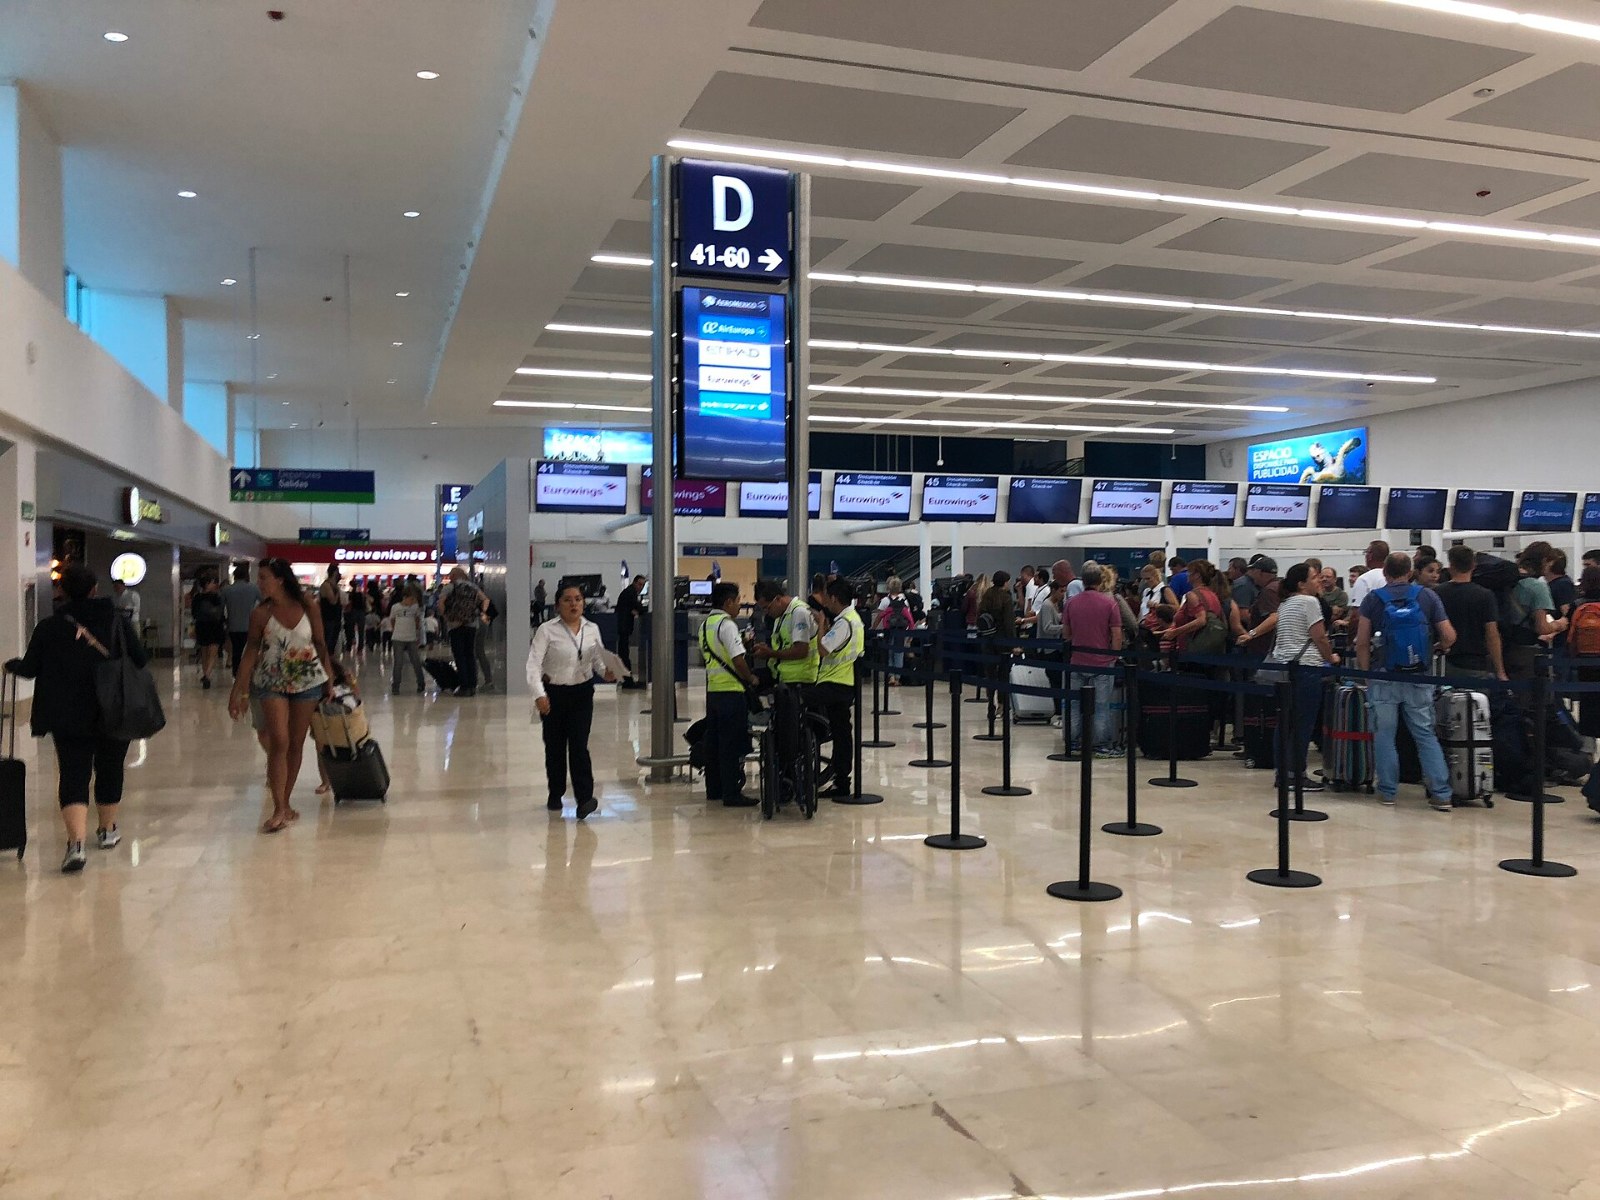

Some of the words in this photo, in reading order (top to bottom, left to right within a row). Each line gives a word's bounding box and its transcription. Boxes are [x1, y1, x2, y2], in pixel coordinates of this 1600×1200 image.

[712, 175, 754, 232] D
[690, 243, 750, 269] 41-60
[1253, 447, 1292, 463] ESPACIO
[539, 463, 554, 474] 41
[643, 467, 652, 478] 4
[1253, 465, 1299, 479] PUBLICIDAD
[836, 474, 851, 484] 44
[926, 477, 940, 487] 45
[1012, 479, 1026, 489] 46
[544, 485, 604, 497] Eurowings
[1095, 482, 1108, 490] 47
[1174, 484, 1187, 492] 48
[1250, 486, 1262, 494] 49
[450, 486, 461, 503] E
[647, 488, 706, 502] Ewings
[747, 491, 789, 502] Eurowin
[1322, 488, 1334, 496] 50
[1391, 490, 1401, 498] 51
[1458, 491, 1470, 500] 52
[840, 495, 891, 506] Eurowings
[928, 497, 978, 507] Eurowings
[1096, 501, 1142, 511] Eurowings
[1175, 502, 1219, 512] Eurowings
[1251, 503, 1293, 514] Eurowings
[334, 549, 427, 561] Convenience
